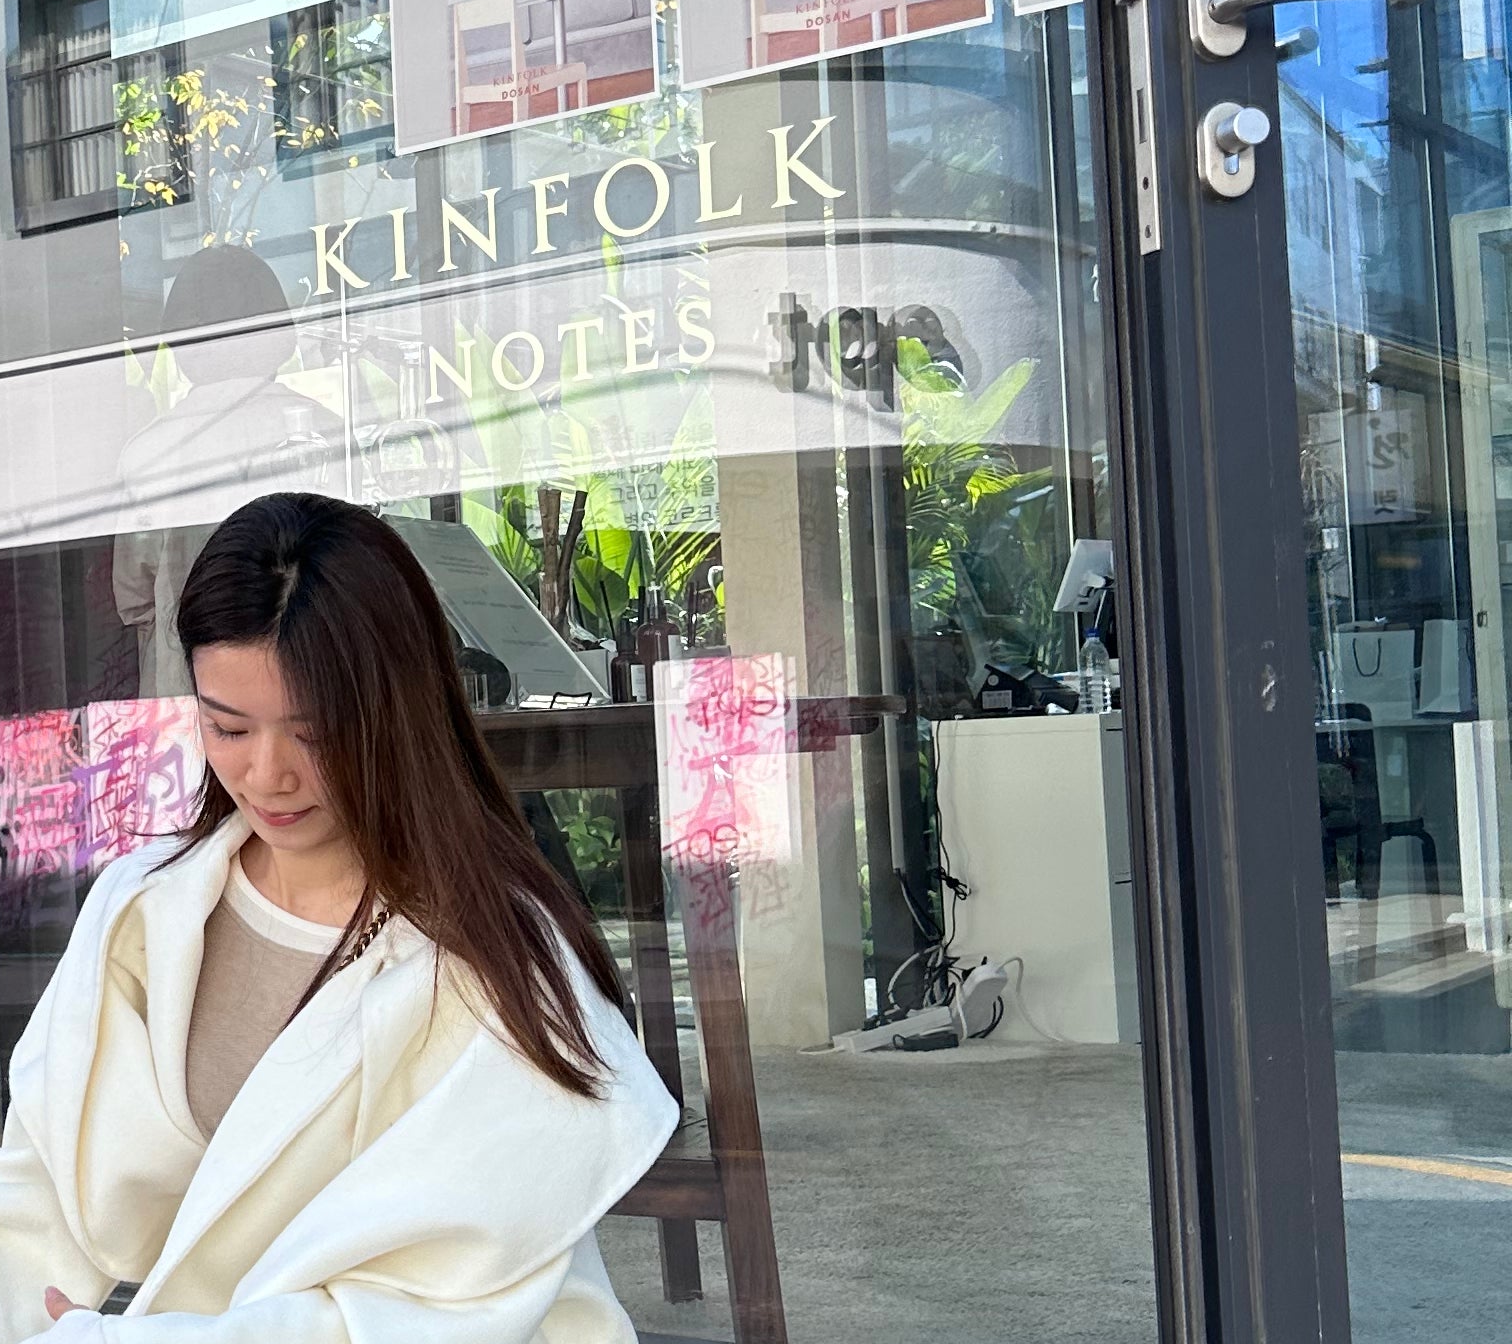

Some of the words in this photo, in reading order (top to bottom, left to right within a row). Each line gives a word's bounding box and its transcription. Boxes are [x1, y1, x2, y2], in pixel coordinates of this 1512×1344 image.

[805, 9, 851, 29] DOSAN
[501, 84, 540, 100] DOSAN
[309, 115, 847, 296] KINFOLK
[426, 298, 716, 406] NOTES
